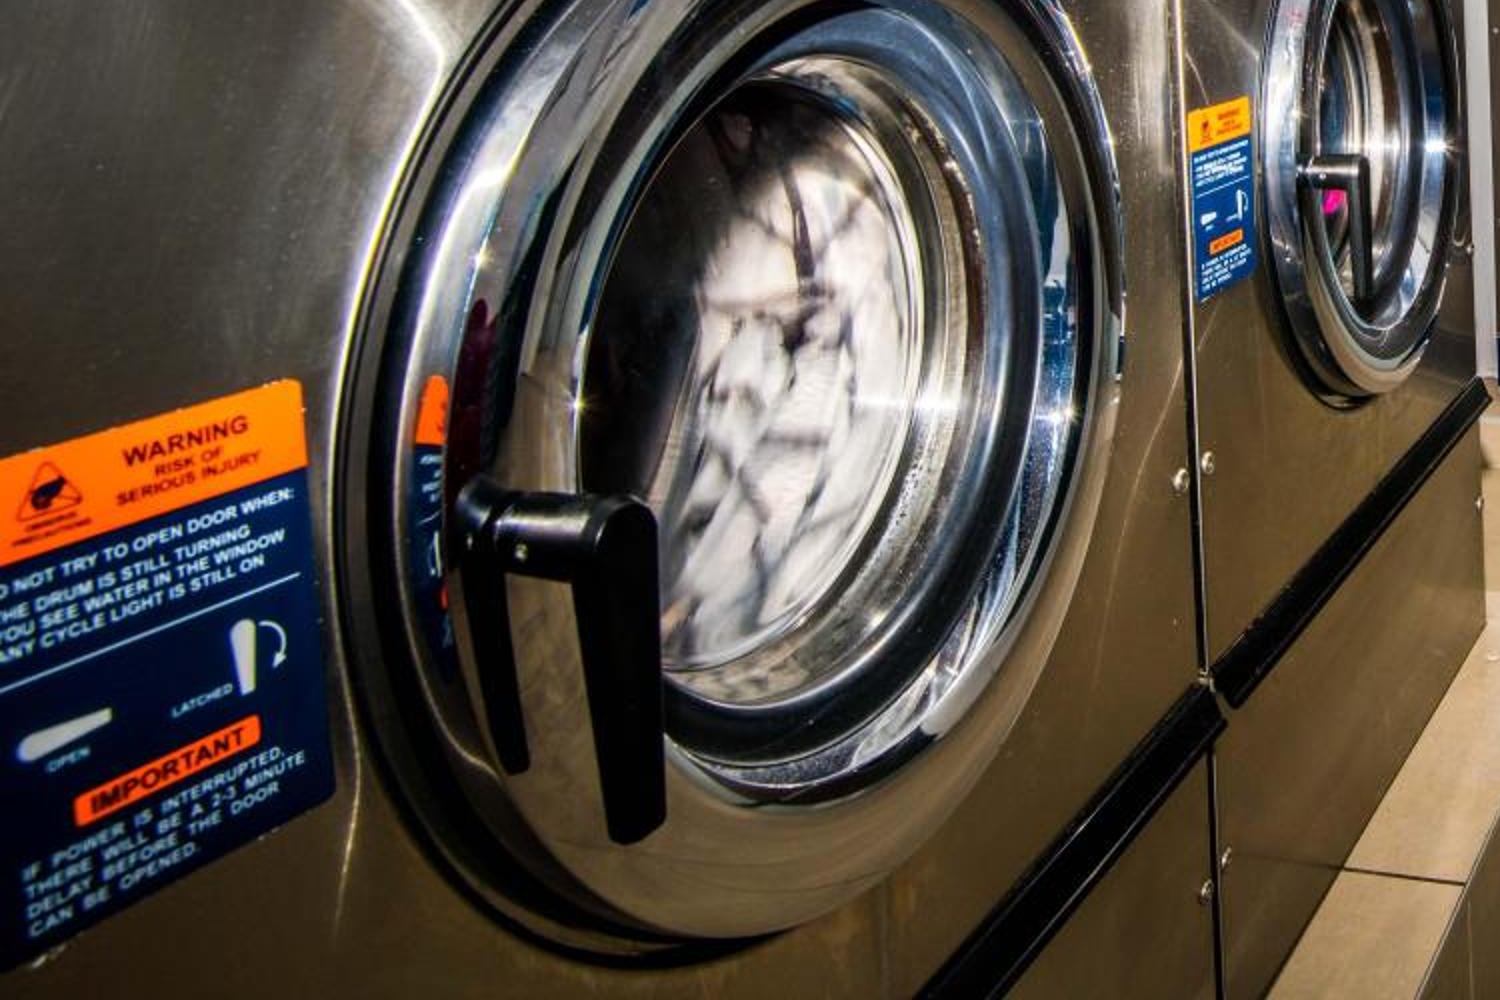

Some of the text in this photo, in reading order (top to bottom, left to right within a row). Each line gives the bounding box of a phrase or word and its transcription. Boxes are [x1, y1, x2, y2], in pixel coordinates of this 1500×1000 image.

[116, 450, 262, 506] SERIOUS INJURY
[122, 414, 249, 468] WARNING
[155, 446, 224, 477] RISK OF
[0, 524, 251, 624] HE DRUM IS STILL TURNING
[13, 487, 295, 593] NOT TRY TO OPEN DOOR WHEN:
[41, 602, 80, 629] SEE
[84, 579, 149, 613] WATER
[153, 566, 172, 588] IN
[176, 554, 211, 579] THE
[213, 529, 286, 565] WINDOW
[40, 612, 107, 649] CYCLE
[109, 591, 165, 622] LIGHT
[168, 579, 186, 600] IS
[190, 566, 237, 592] STILL
[239, 554, 265, 576] ON
[171, 683, 234, 718] LATCHED
[45, 747, 91, 773] OPEN
[89, 727, 246, 814] IMPORTANT
[22, 861, 42, 884] IF
[51, 821, 126, 866] POWER
[135, 808, 153, 829] IS
[24, 750, 306, 900] THERE WILL BE A 2-3 MINUTE
[26, 781, 280, 920] DELAY BEFORE THE DOOR
[28, 908, 73, 939] CAN
[83, 887, 111, 912] BE
